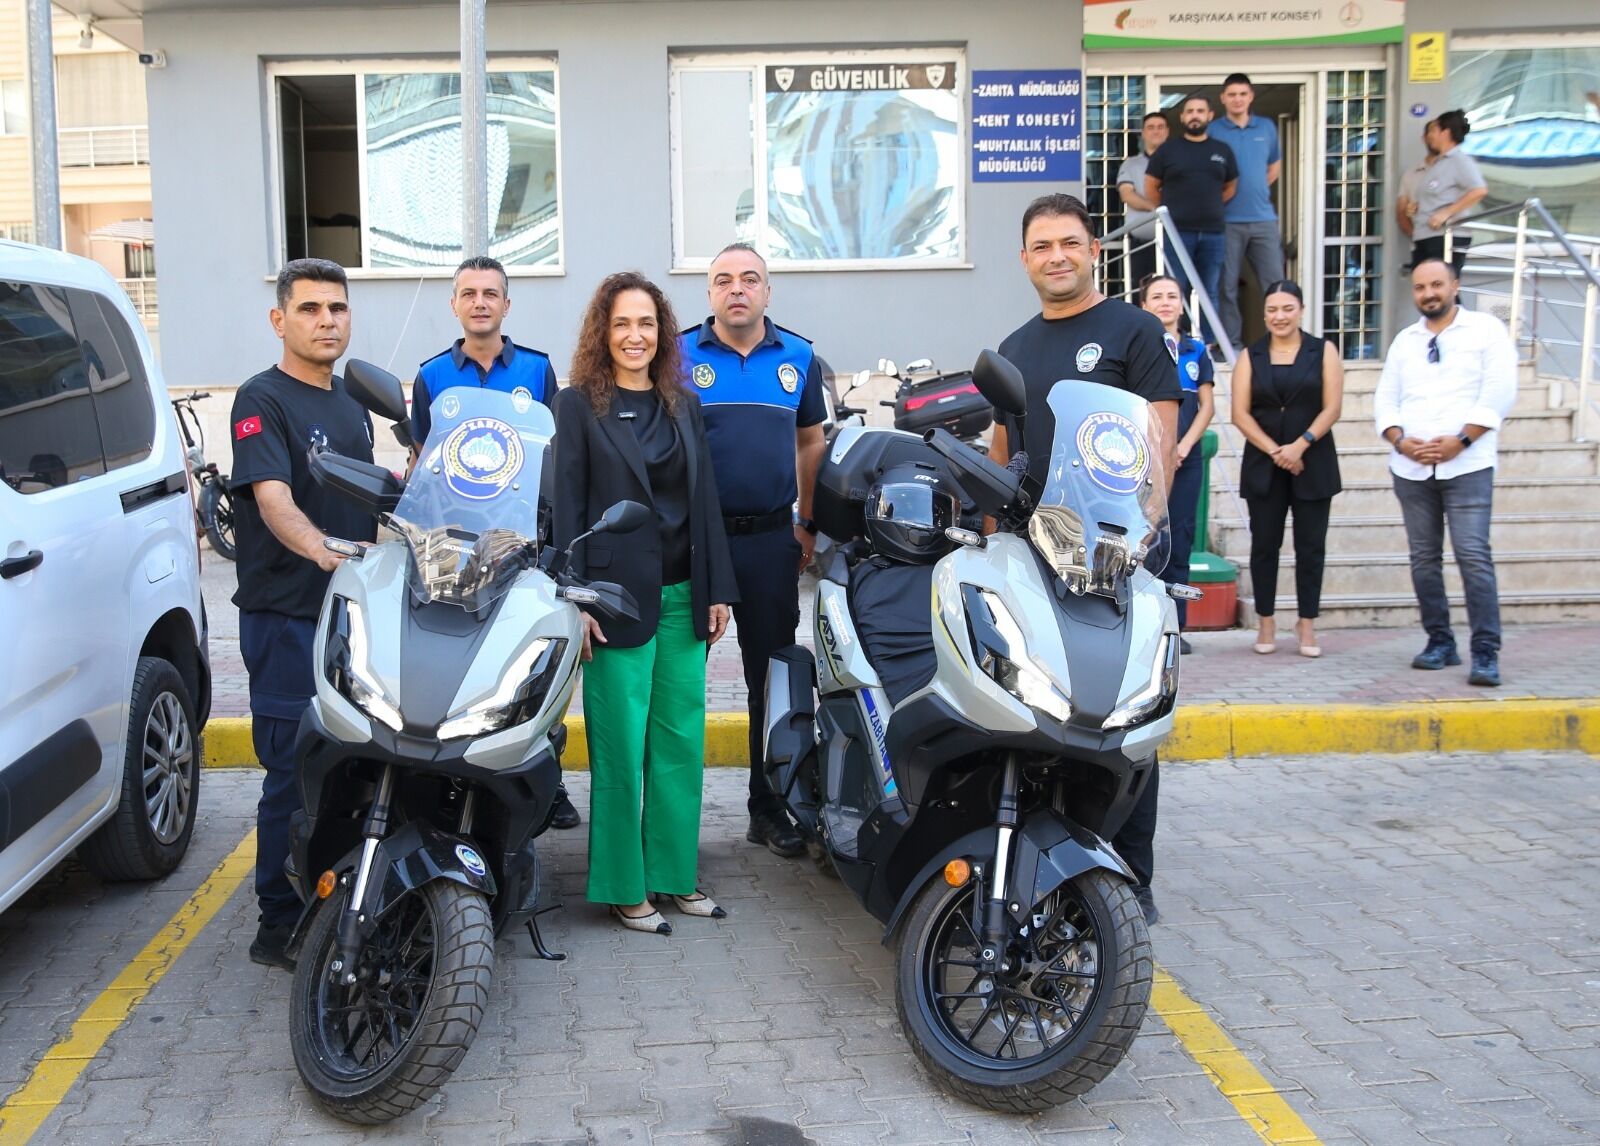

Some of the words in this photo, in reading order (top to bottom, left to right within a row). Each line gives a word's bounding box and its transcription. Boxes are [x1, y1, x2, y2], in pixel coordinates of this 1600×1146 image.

[1168, 12, 1235, 24] KARŞIYAKA
[1237, 11, 1267, 22] KENT
[1271, 9, 1322, 21] KONSEYİ
[810, 65, 911, 90] GÜVENLİK
[1016, 109, 1076, 126] KONSEYİ
[1044, 134, 1081, 154] İŞLERİ
